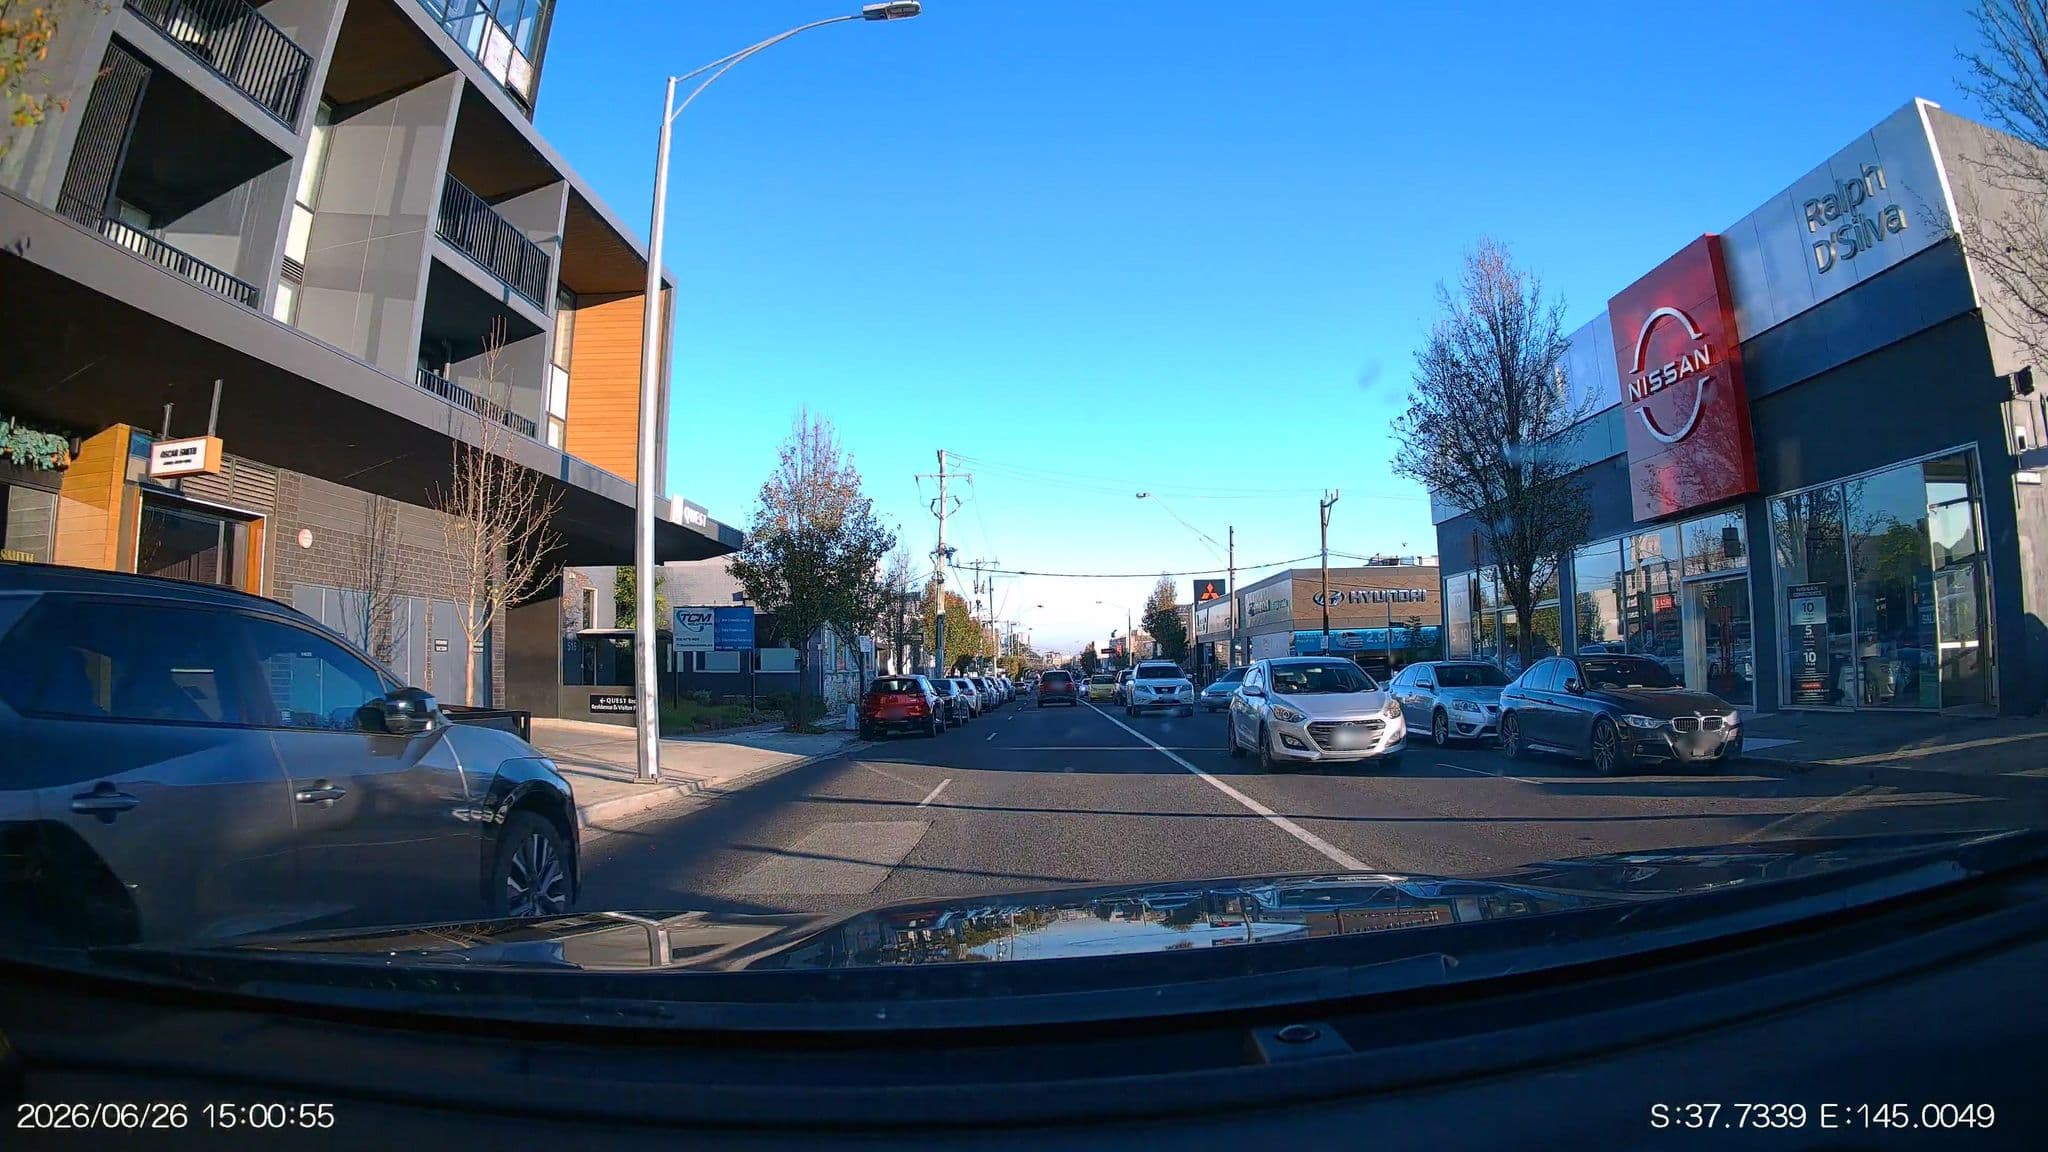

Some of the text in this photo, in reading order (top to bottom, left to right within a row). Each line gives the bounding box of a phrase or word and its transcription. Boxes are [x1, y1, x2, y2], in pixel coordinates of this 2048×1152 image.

[1803, 162, 1887, 233] Ralph
[1812, 204, 1908, 274] D'Silva
[1628, 343, 1711, 402] NISSAN
[160, 446, 197, 459] OSCAR SMITH
[683, 506, 707, 528] QUEST
[1349, 588, 1427, 604] HYUNDAI
[1801, 602, 1815, 613] 10
[680, 613, 713, 623] TCM
[1804, 625, 1813, 635] 5
[1803, 651, 1817, 663] 10
